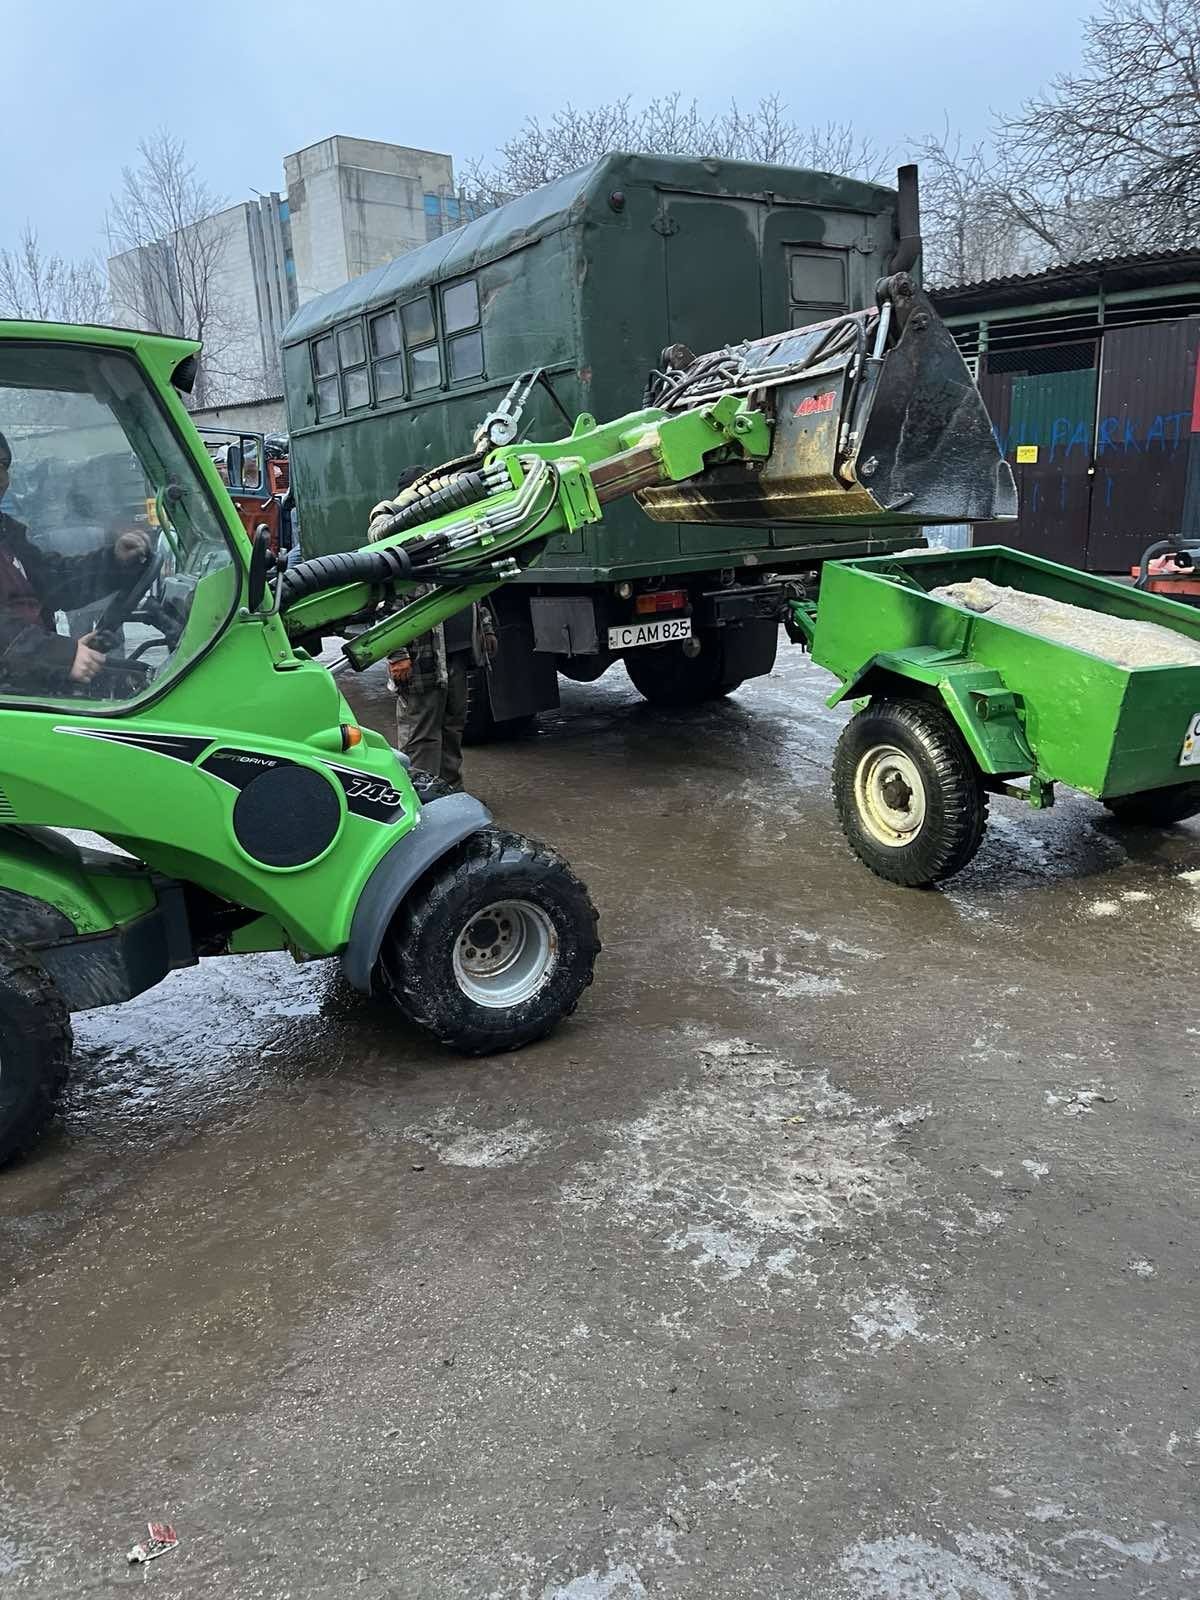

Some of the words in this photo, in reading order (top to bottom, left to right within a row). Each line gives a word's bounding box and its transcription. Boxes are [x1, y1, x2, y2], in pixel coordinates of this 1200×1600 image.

[621, 629, 633, 645] C
[636, 625, 659, 644] AM
[662, 621, 688, 639] 825
[345, 778, 402, 806] 745
